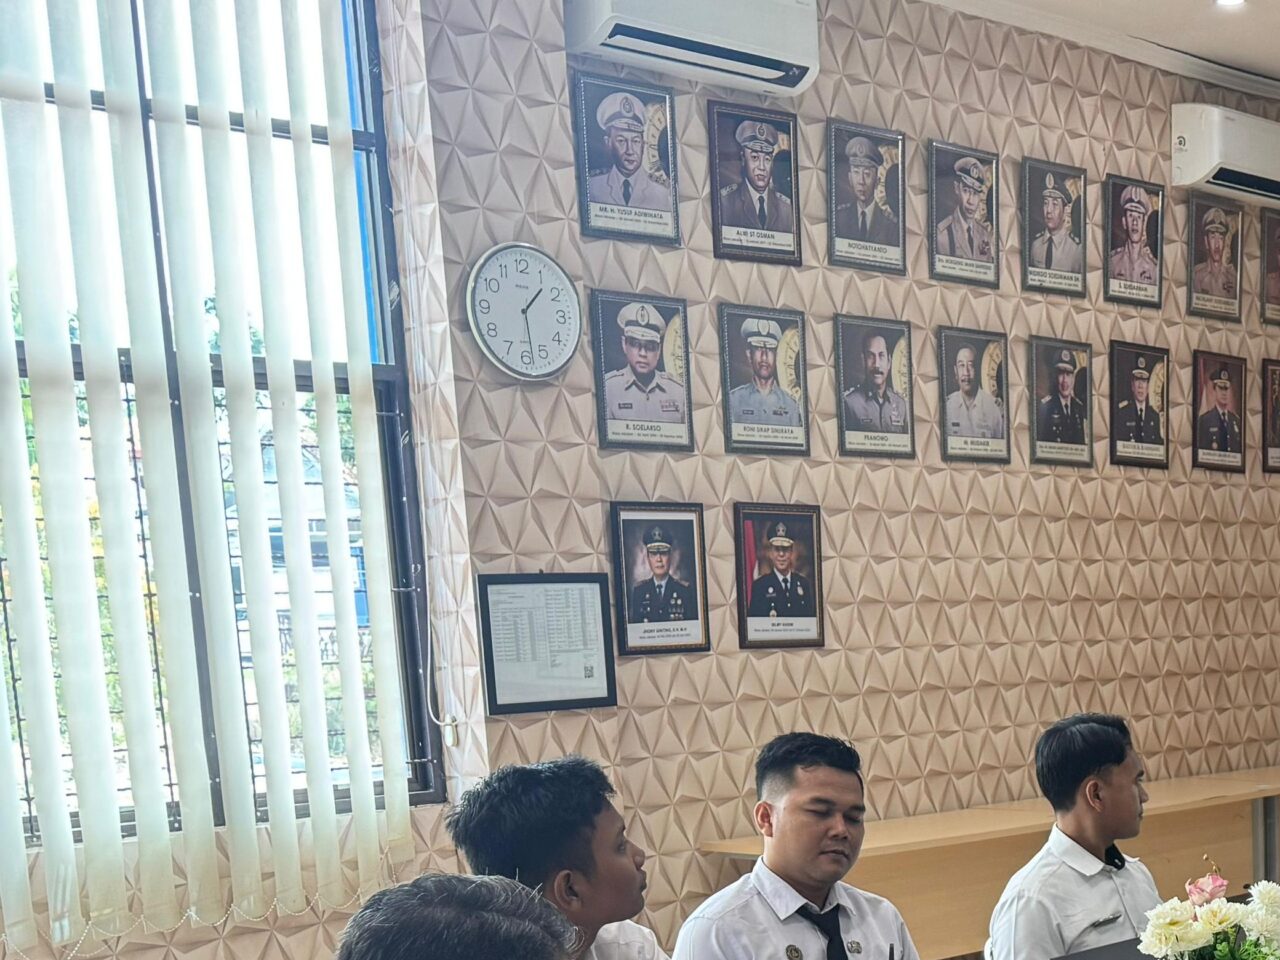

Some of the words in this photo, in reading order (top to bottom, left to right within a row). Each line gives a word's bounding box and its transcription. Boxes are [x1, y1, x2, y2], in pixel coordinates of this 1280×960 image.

[499, 264, 508, 278] 11
[515, 259, 529, 274] 12
[484, 278, 500, 293] 10
[550, 287, 561, 302] 2
[479, 299, 490, 314] 9
[556, 310, 567, 324] 3
[487, 322, 498, 337] 8
[552, 331, 563, 345] 4
[503, 340, 514, 355] 7
[538, 345, 549, 359] 5
[520, 350, 532, 365] 6
